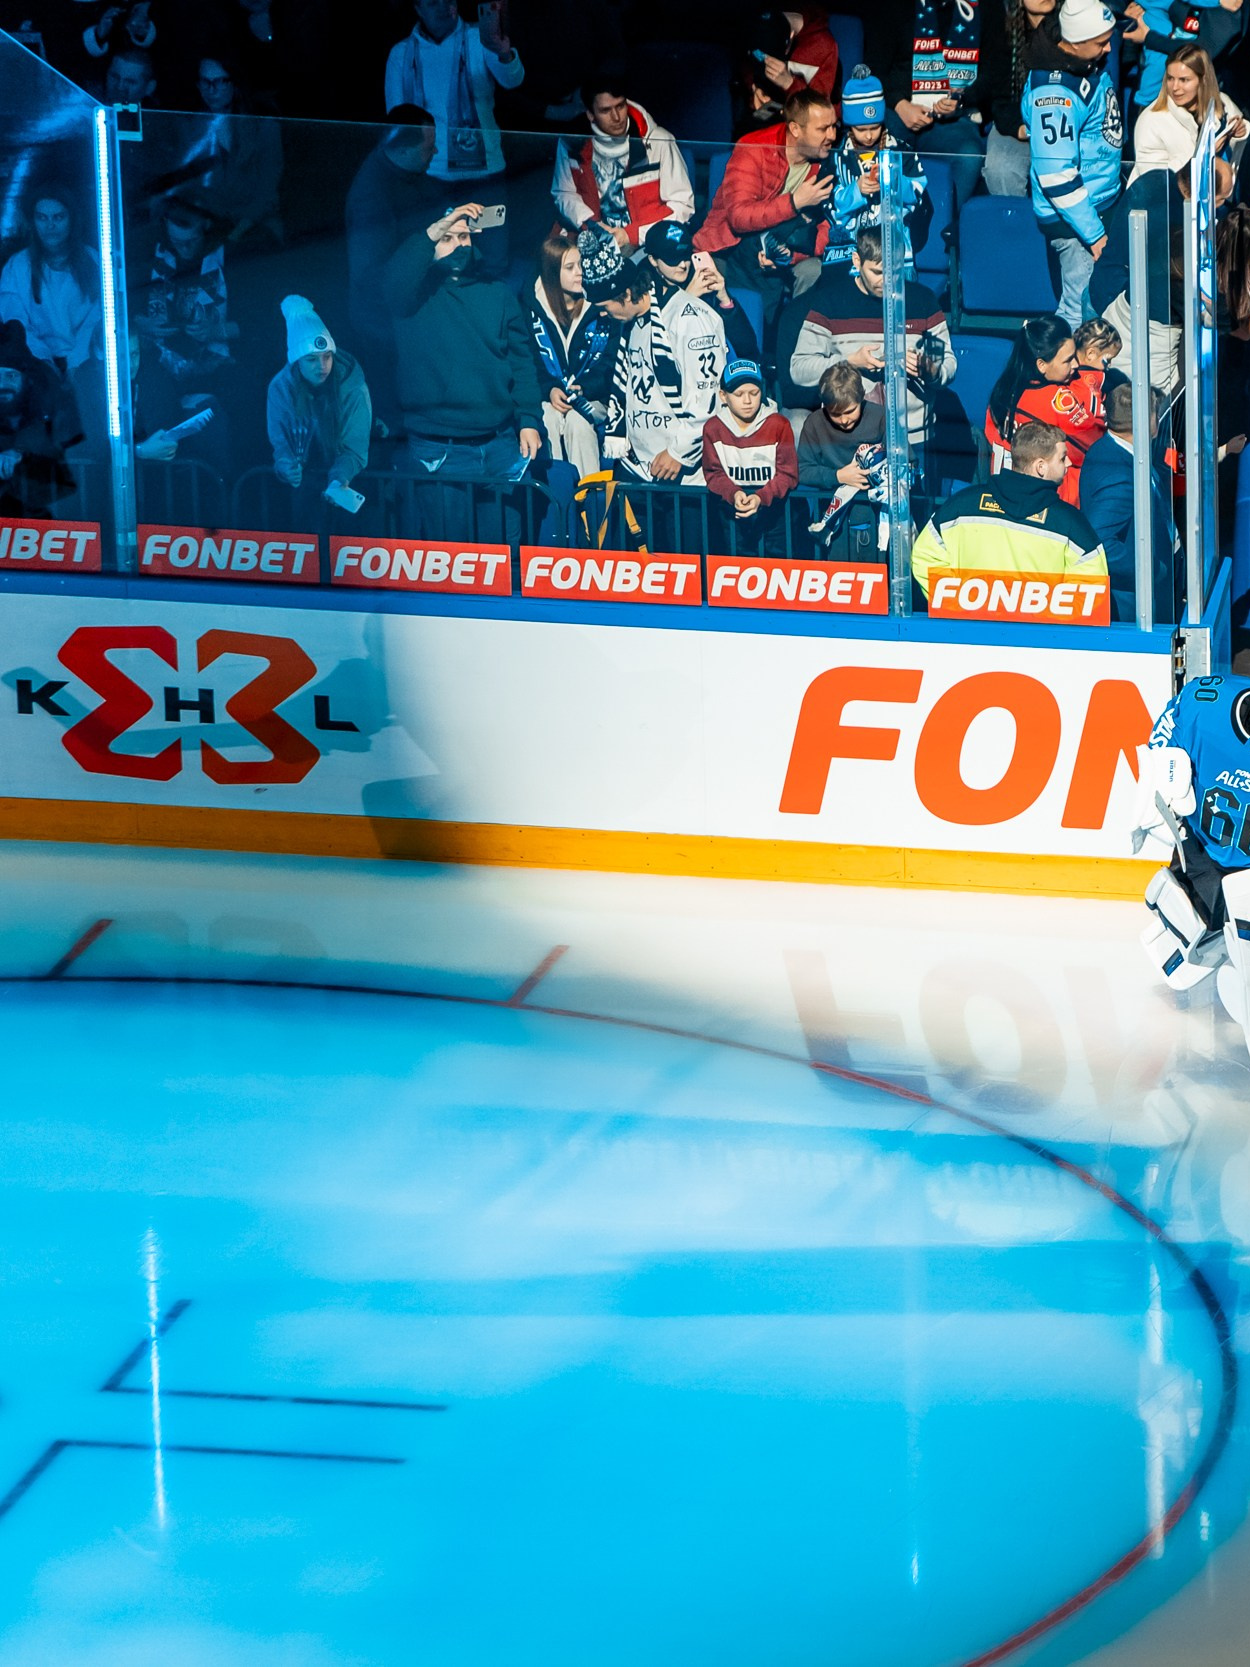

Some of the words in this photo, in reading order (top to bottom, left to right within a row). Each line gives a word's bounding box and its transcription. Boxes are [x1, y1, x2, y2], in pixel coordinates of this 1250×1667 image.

[943, 49, 977, 60] FONBET
[1037, 97, 1064, 106] Winline
[1041, 112, 1074, 145] 54
[142, 534, 315, 575] FONBET
[334, 546, 507, 586] FONBET
[524, 556, 697, 596] FONBET
[711, 566, 884, 605] FONBET
[932, 577, 1107, 617] FONBET
